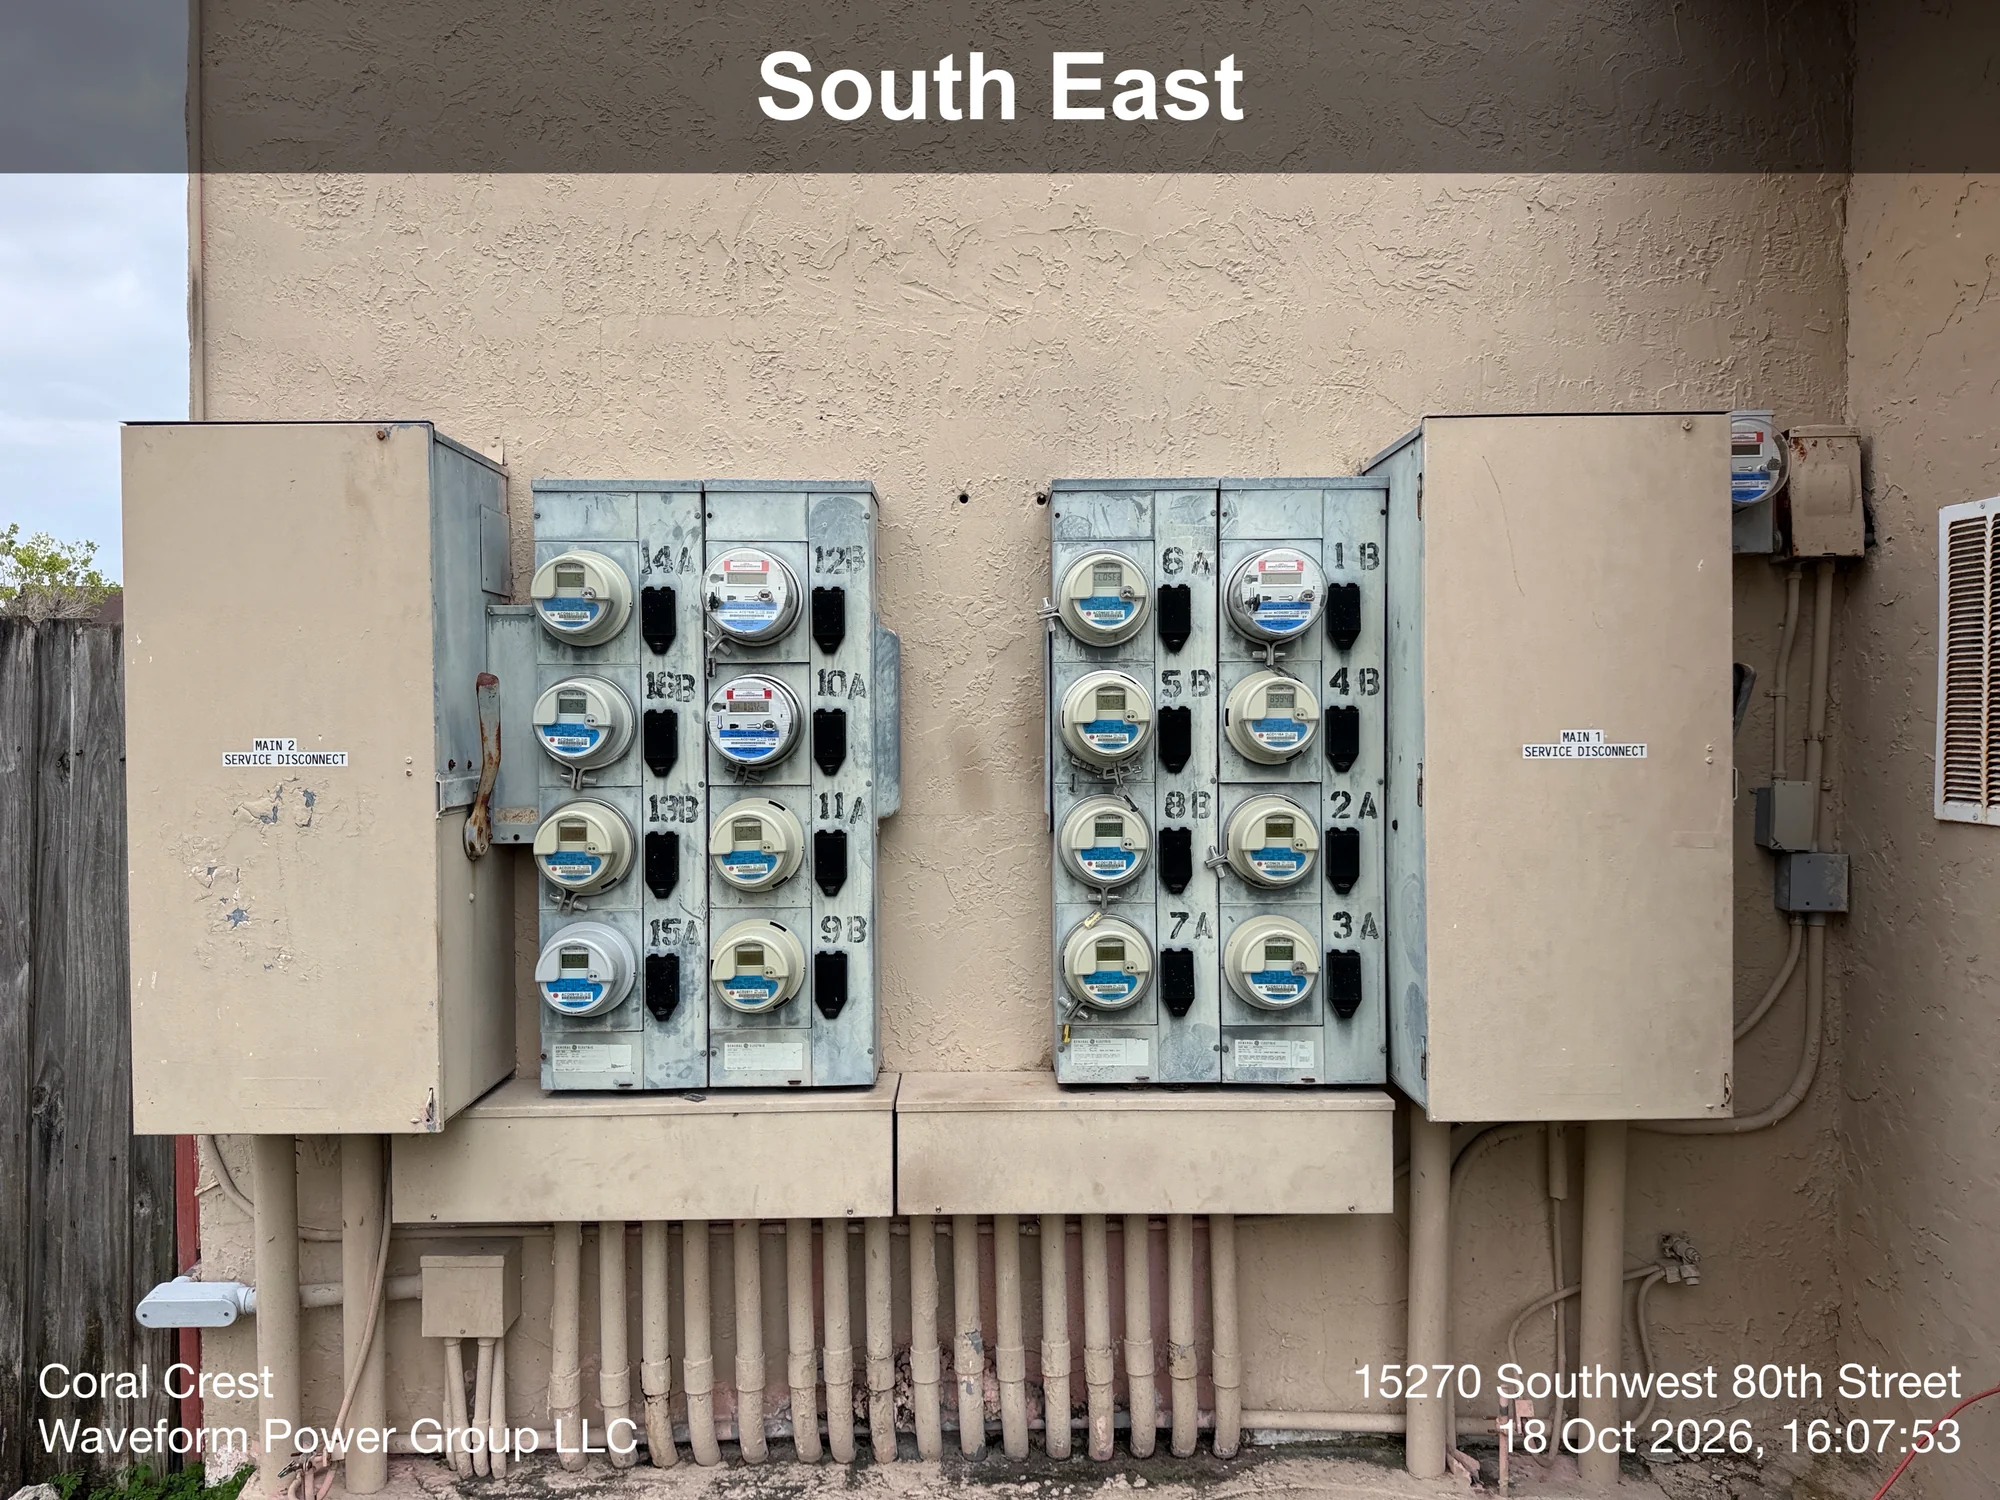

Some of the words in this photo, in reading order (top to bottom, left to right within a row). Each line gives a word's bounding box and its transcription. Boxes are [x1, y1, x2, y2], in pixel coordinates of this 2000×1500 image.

[815, 545, 866, 575] 12B
[817, 668, 867, 700] 10A
[255, 740, 283, 751] MAIN
[287, 740, 295, 751] 2
[1562, 731, 1590, 743] MAIN
[1595, 731, 1602, 743] 1
[224, 754, 272, 765] SERVICE
[277, 754, 346, 765] DISCONNECT
[1524, 746, 1572, 757] SERVICE
[1577, 745, 1645, 757] DISCONNECT
[649, 794, 700, 824] 13B
[650, 918, 701, 947] 15A
